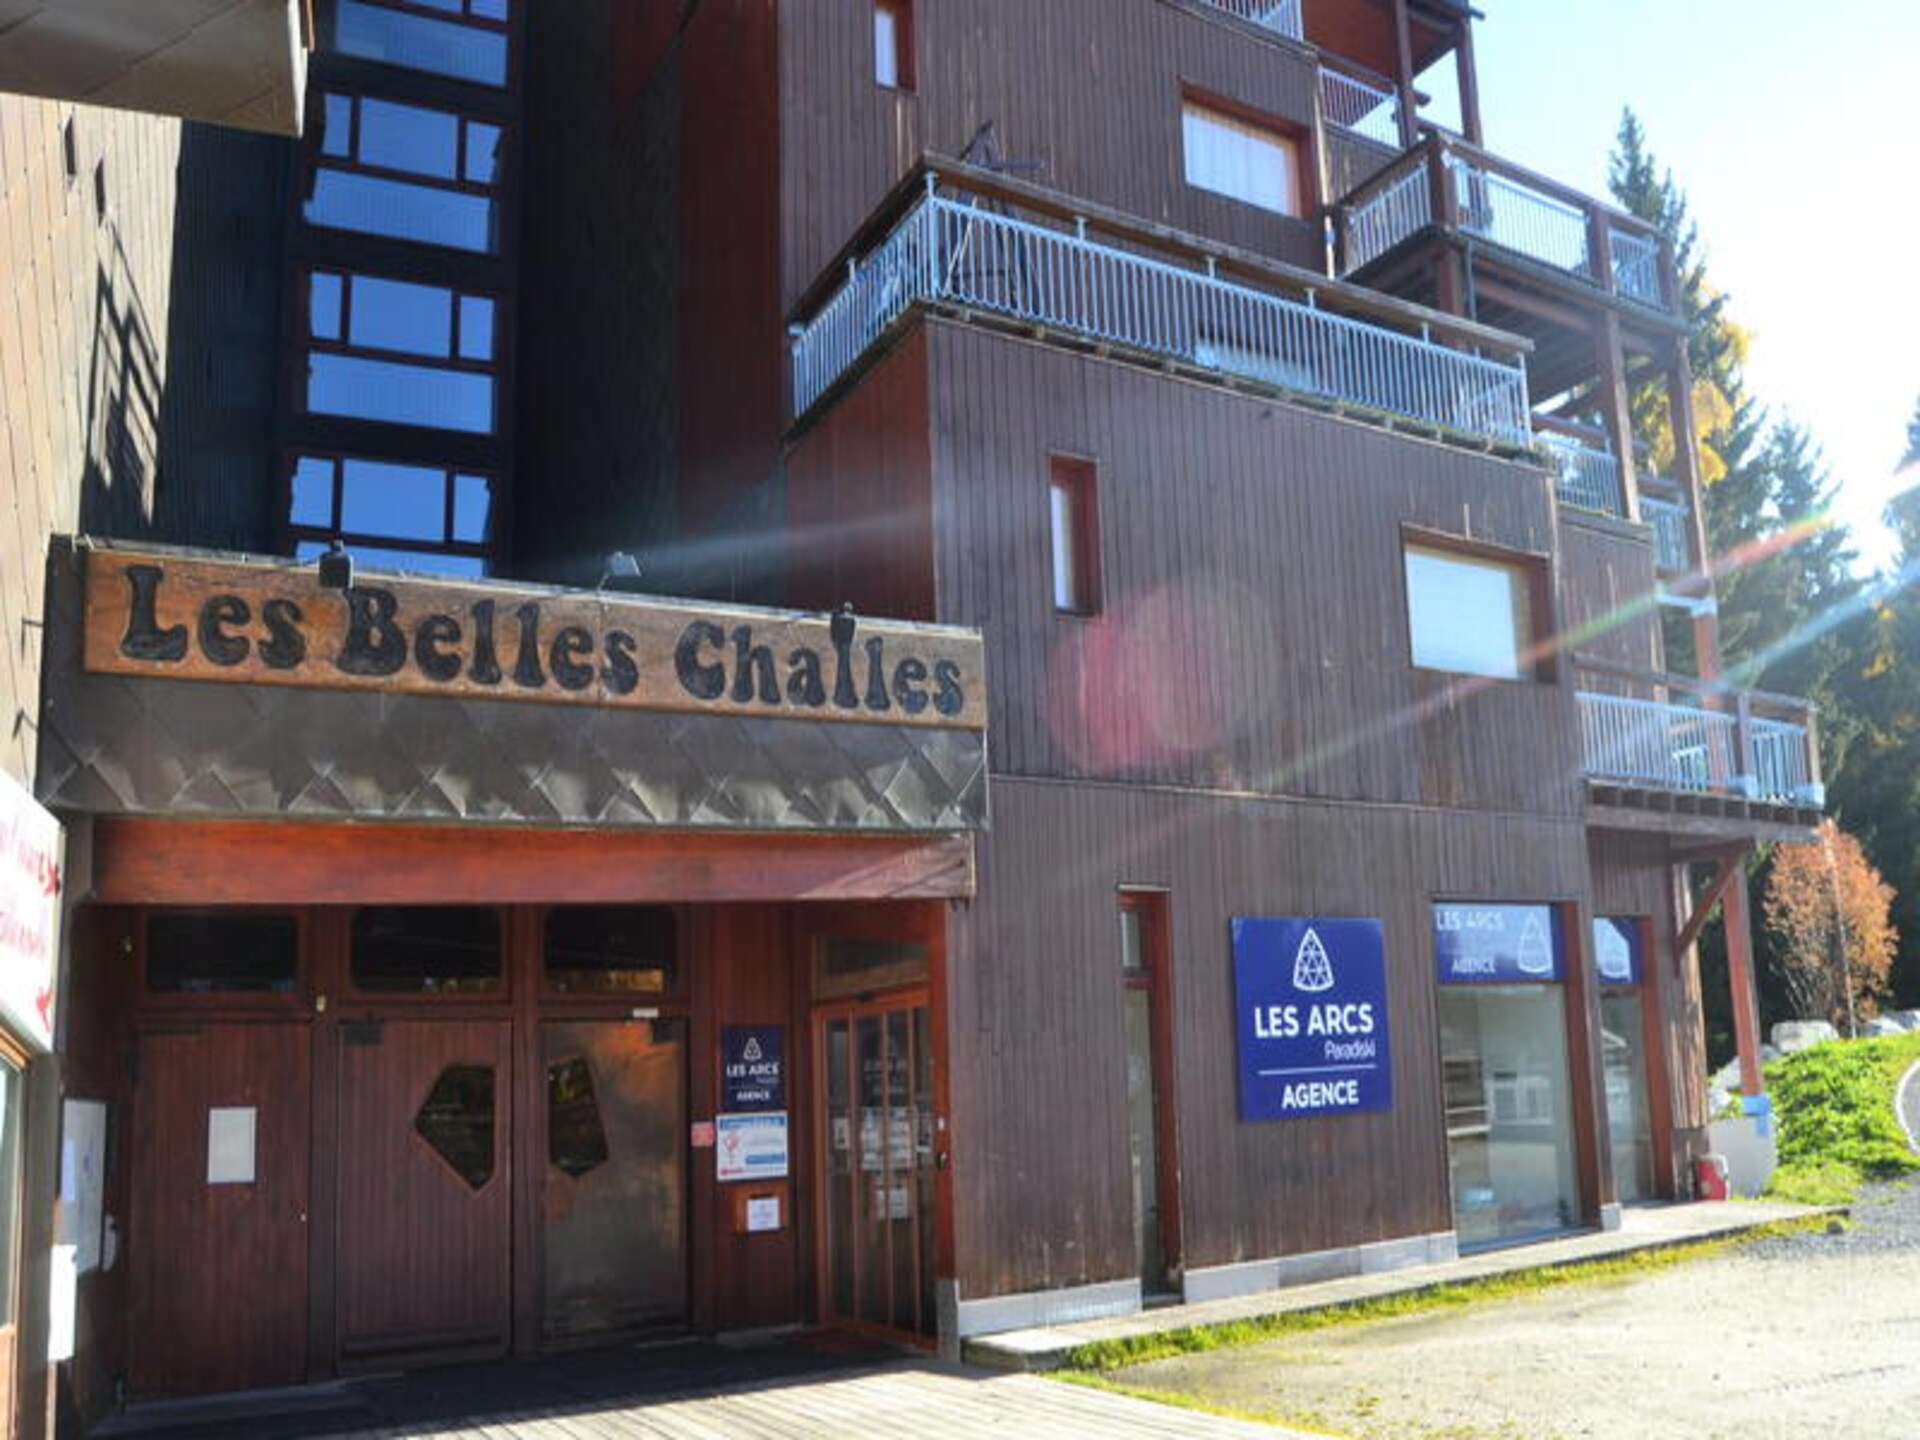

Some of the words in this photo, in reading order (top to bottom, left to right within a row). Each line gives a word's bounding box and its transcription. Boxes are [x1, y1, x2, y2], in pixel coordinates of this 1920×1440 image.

[120, 564, 306, 669] Les
[337, 586, 639, 695] Belles
[674, 619, 964, 716] Challes
[1436, 911, 1461, 931] LES
[1452, 957, 1496, 975] AGENCE
[1254, 1005, 1299, 1038] LES
[1307, 1003, 1374, 1036] ARCS
[726, 1063, 746, 1077] LES
[1282, 1079, 1359, 1109] AGENCE
